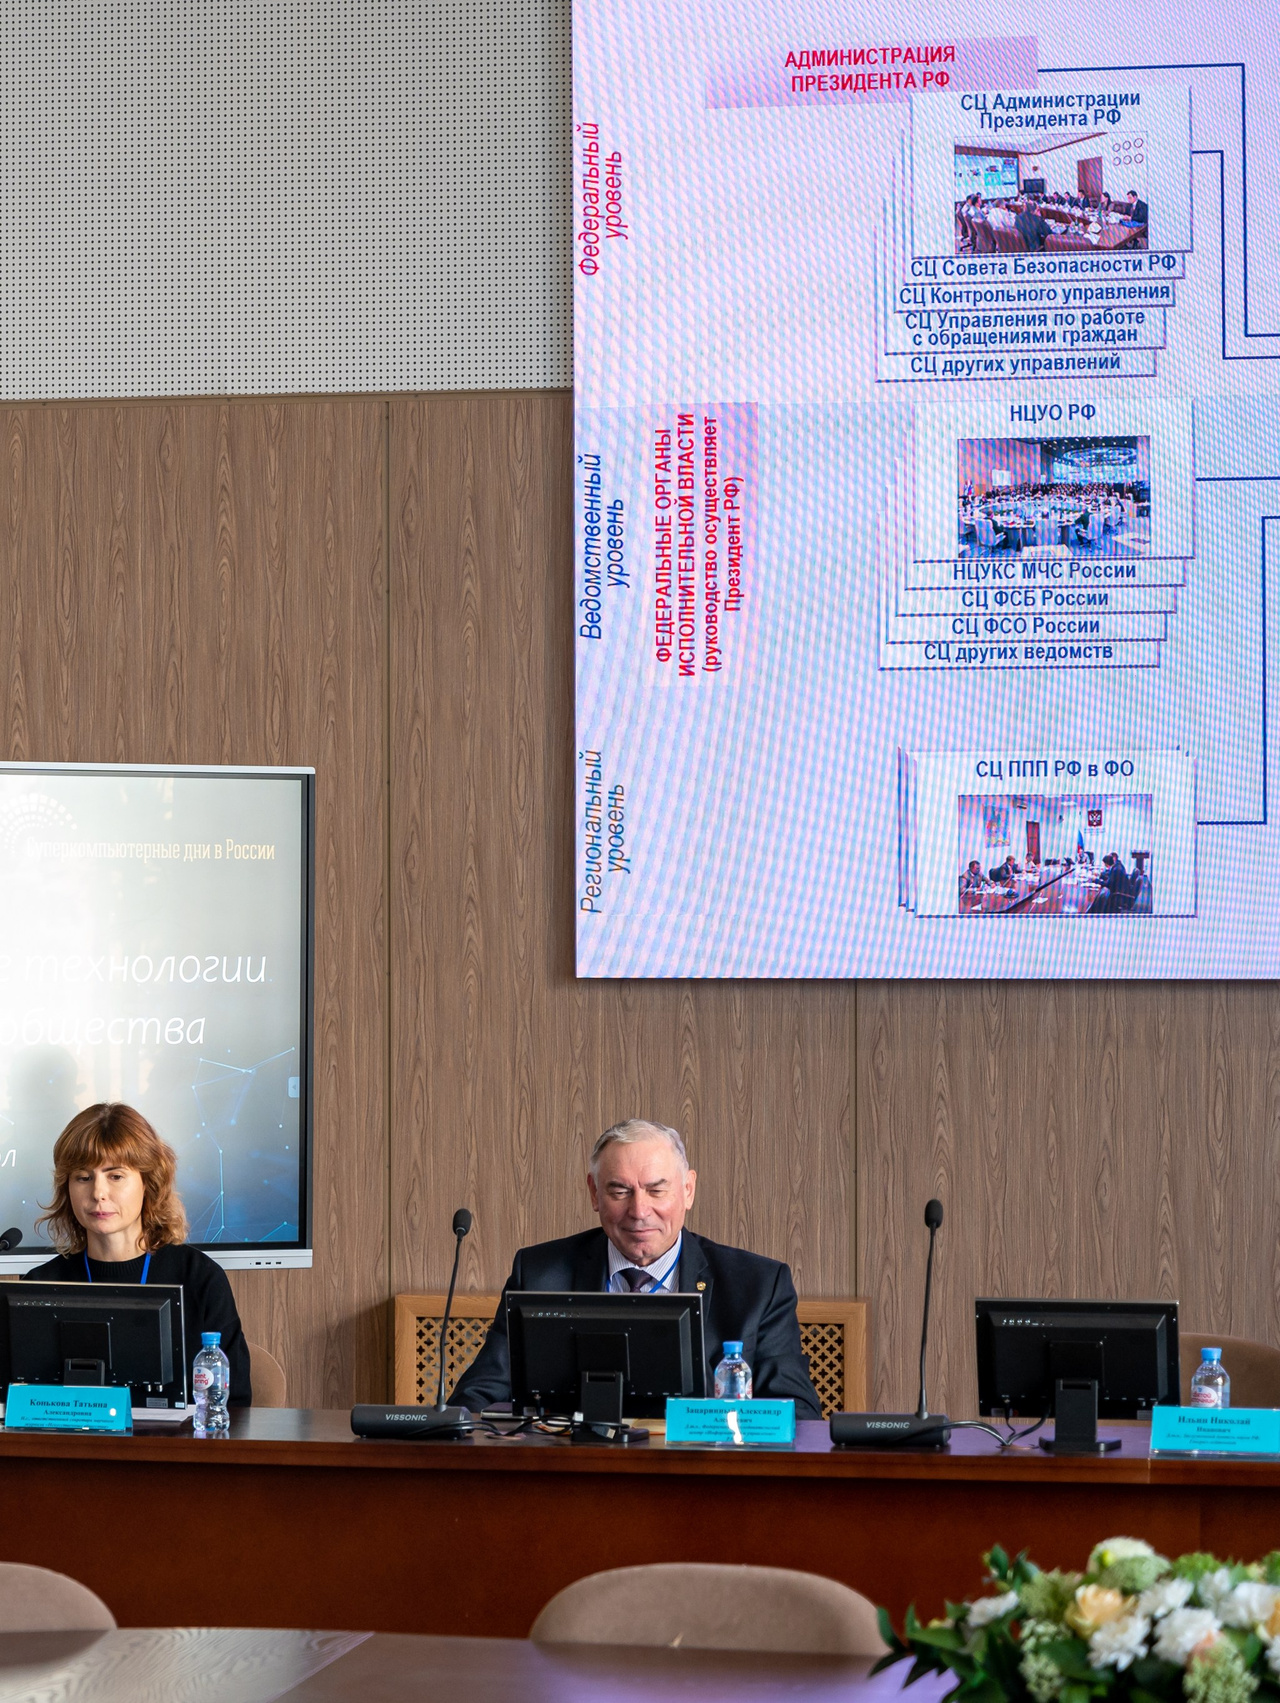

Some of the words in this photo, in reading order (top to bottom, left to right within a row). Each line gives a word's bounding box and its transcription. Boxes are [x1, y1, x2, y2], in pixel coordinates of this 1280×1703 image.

[785, 45, 956, 70] АДМИНИСТРАЦИЯ
[791, 71, 917, 93] ПРЕЗИДЕНТА
[923, 70, 951, 90] РФ
[961, 94, 987, 111] СЦ
[993, 92, 1141, 110] Администрации
[980, 110, 1088, 131] Президента
[1094, 108, 1121, 126] РФ
[576, 122, 605, 275] Федеральный
[605, 151, 628, 240] уровень
[911, 260, 937, 279] СЦ
[942, 259, 1008, 276] Совета
[1013, 257, 1143, 275] Безопасности
[1149, 254, 1177, 271] РФ
[900, 288, 926, 306] СЦ
[931, 286, 1057, 306] Контрольного
[1062, 284, 1170, 304] управления
[905, 312, 932, 331] СЦ
[937, 310, 1048, 331] Управления
[1054, 312, 1076, 326] по
[1082, 308, 1145, 329] работе
[913, 333, 922, 346] с
[927, 329, 1056, 348] обращениями
[1063, 327, 1138, 346] граждан
[911, 357, 937, 376] СЦ
[942, 357, 1005, 377] других
[1010, 353, 1121, 374] управлений
[1010, 404, 1063, 423] НЦУО
[1069, 403, 1096, 421] РФ
[677, 413, 695, 490] ВЛАСТИ
[655, 429, 671, 509] ОРГАНЫ
[705, 416, 721, 545] осуществляет
[724, 476, 744, 510] РФ)
[578, 453, 602, 640] Ведомственный
[607, 498, 630, 588] уровень
[724, 514, 744, 612] Президент
[953, 563, 1016, 582] НЦУКС
[1022, 562, 1063, 579] МЧС
[1070, 561, 1136, 579] России
[655, 515, 675, 662] ФЕДЕРАЛЬНЫЕ
[674, 495, 695, 677] ИСПОЛНИТЕЛЬНОЙ
[962, 590, 988, 609] СЦ
[995, 589, 1036, 607] ФСБ
[1042, 588, 1109, 606] России
[702, 550, 722, 673] (руководство
[952, 618, 978, 637] СЦ
[984, 617, 1027, 635] ФСО
[1033, 616, 1100, 634] России
[924, 644, 951, 662] СЦ
[955, 644, 1018, 664] других
[1024, 645, 1113, 661] ведомств
[976, 761, 1003, 780] СЦ
[1009, 760, 1048, 777] ППП
[1055, 760, 1082, 777] РФ
[1088, 765, 1099, 777] в
[1104, 760, 1135, 777] ФО
[579, 750, 602, 913] Региональный
[608, 784, 631, 874] уровень
[26, 836, 180, 864] Суперкомпьютерные
[184, 842, 212, 863] дни
[214, 843, 222, 859] в
[226, 838, 276, 861] России
[25, 954, 267, 984] технологии
[385, 1414, 428, 1422] VISSONIC
[866, 1421, 910, 1429] VISSONIC
